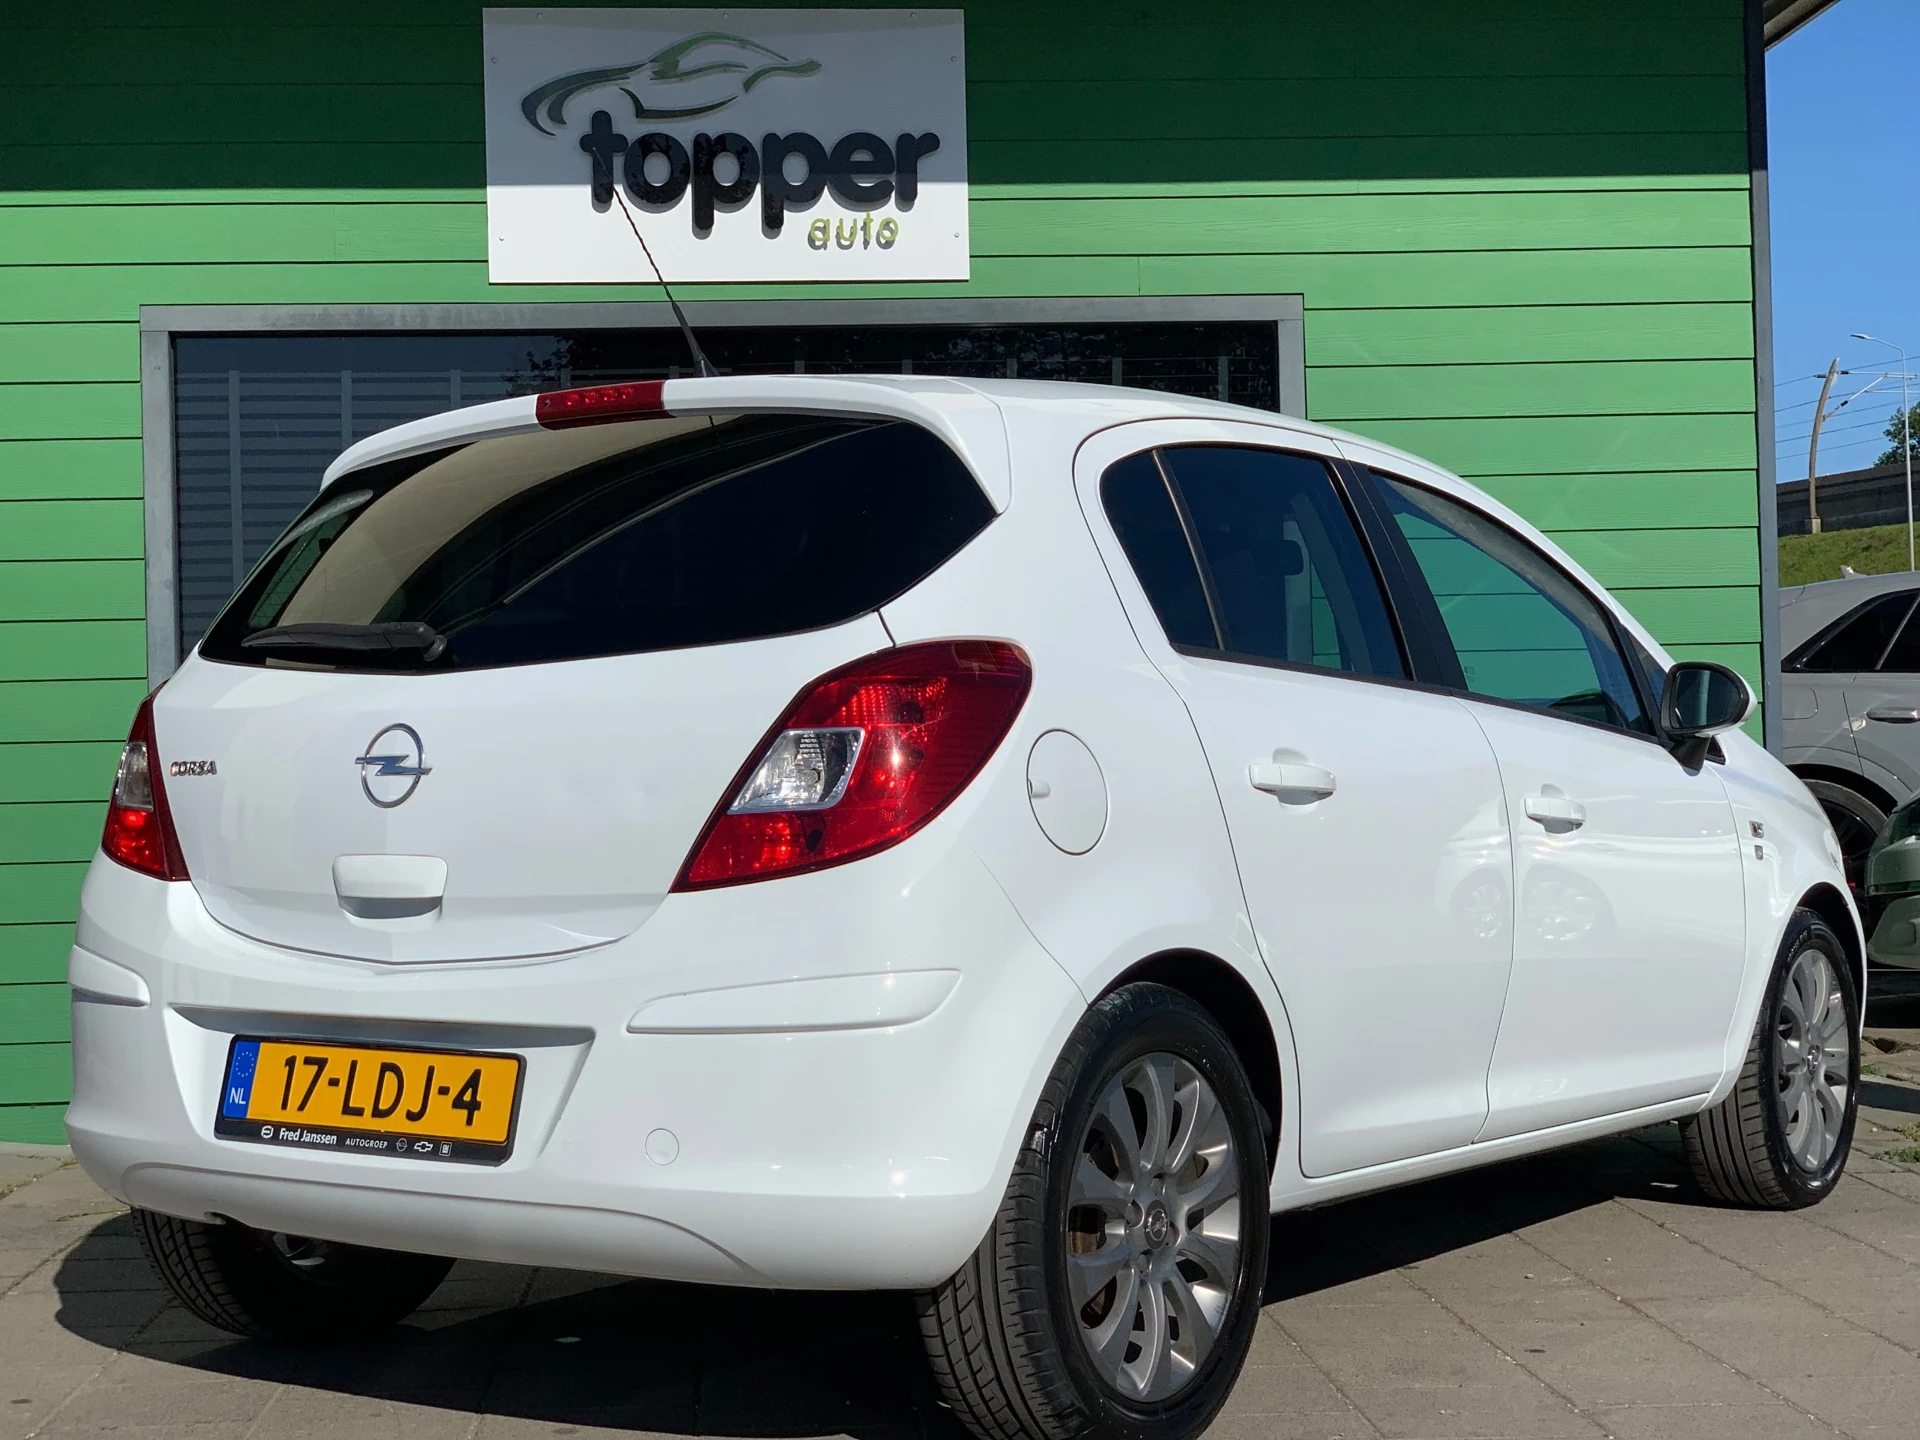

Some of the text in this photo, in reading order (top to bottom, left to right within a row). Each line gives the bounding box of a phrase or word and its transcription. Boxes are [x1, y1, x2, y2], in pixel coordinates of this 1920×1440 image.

[579, 110, 941, 231] topper
[809, 212, 899, 245] auto
[171, 761, 217, 776] CORSA
[229, 1087, 246, 1105] NL
[280, 1055, 482, 1126] 17-LDJ-4
[279, 1127, 388, 1149] Fred Janssen AUTOGROEP
